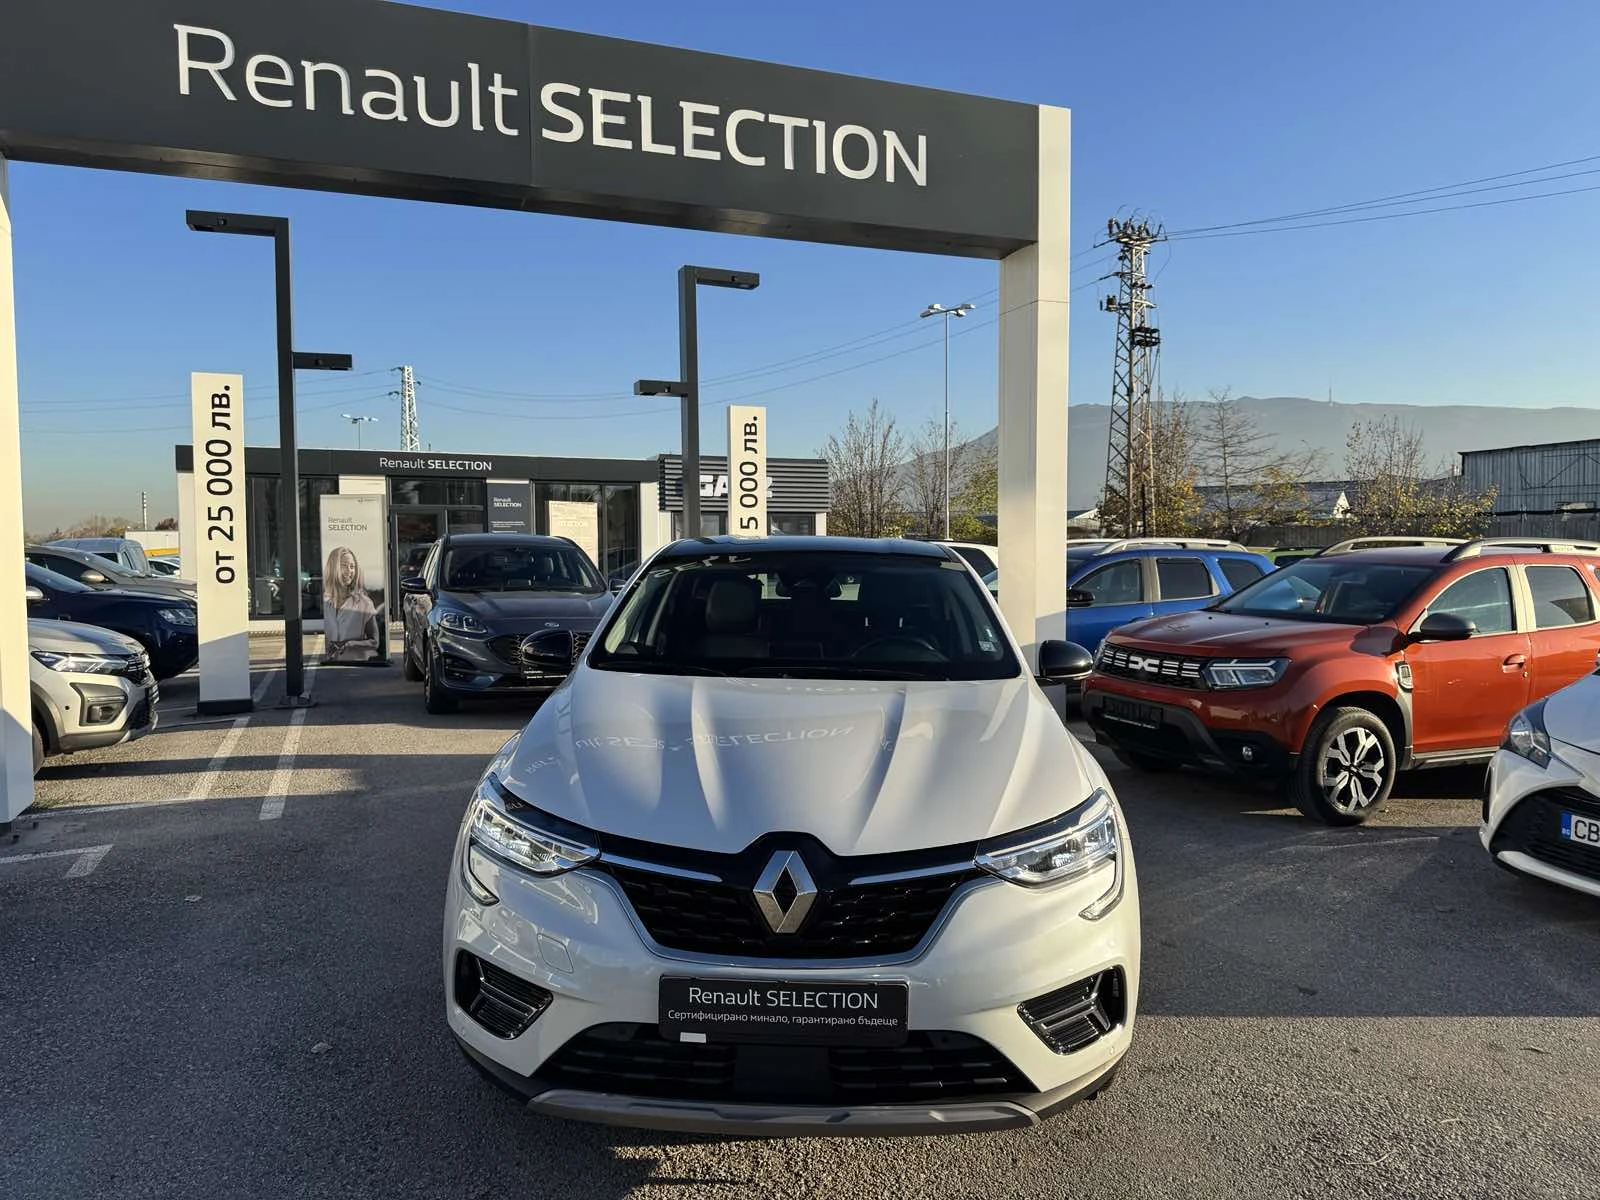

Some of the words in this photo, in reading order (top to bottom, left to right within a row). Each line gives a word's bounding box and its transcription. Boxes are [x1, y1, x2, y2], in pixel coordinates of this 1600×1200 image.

[174, 23, 520, 137] Renault
[540, 82, 928, 187] SELECTION
[211, 385, 232, 431] лв.
[743, 415, 759, 455] лв.
[205, 439, 233, 496] 000
[379, 457, 426, 470] Renault
[427, 459, 493, 472] SELECTION
[739, 461, 759, 509] 000
[207, 506, 234, 542] 25
[327, 516, 353, 524] Renault
[327, 523, 368, 532] SELECTION
[215, 551, 236, 584] от
[689, 986, 761, 1007] Renault
[766, 990, 879, 1010] SELECTION
[667, 1009, 748, 1024] Сертифицирано
[750, 1014, 791, 1025] минало,
[792, 1016, 856, 1028] гарантирано
[857, 1015, 899, 1028] бъдеще
